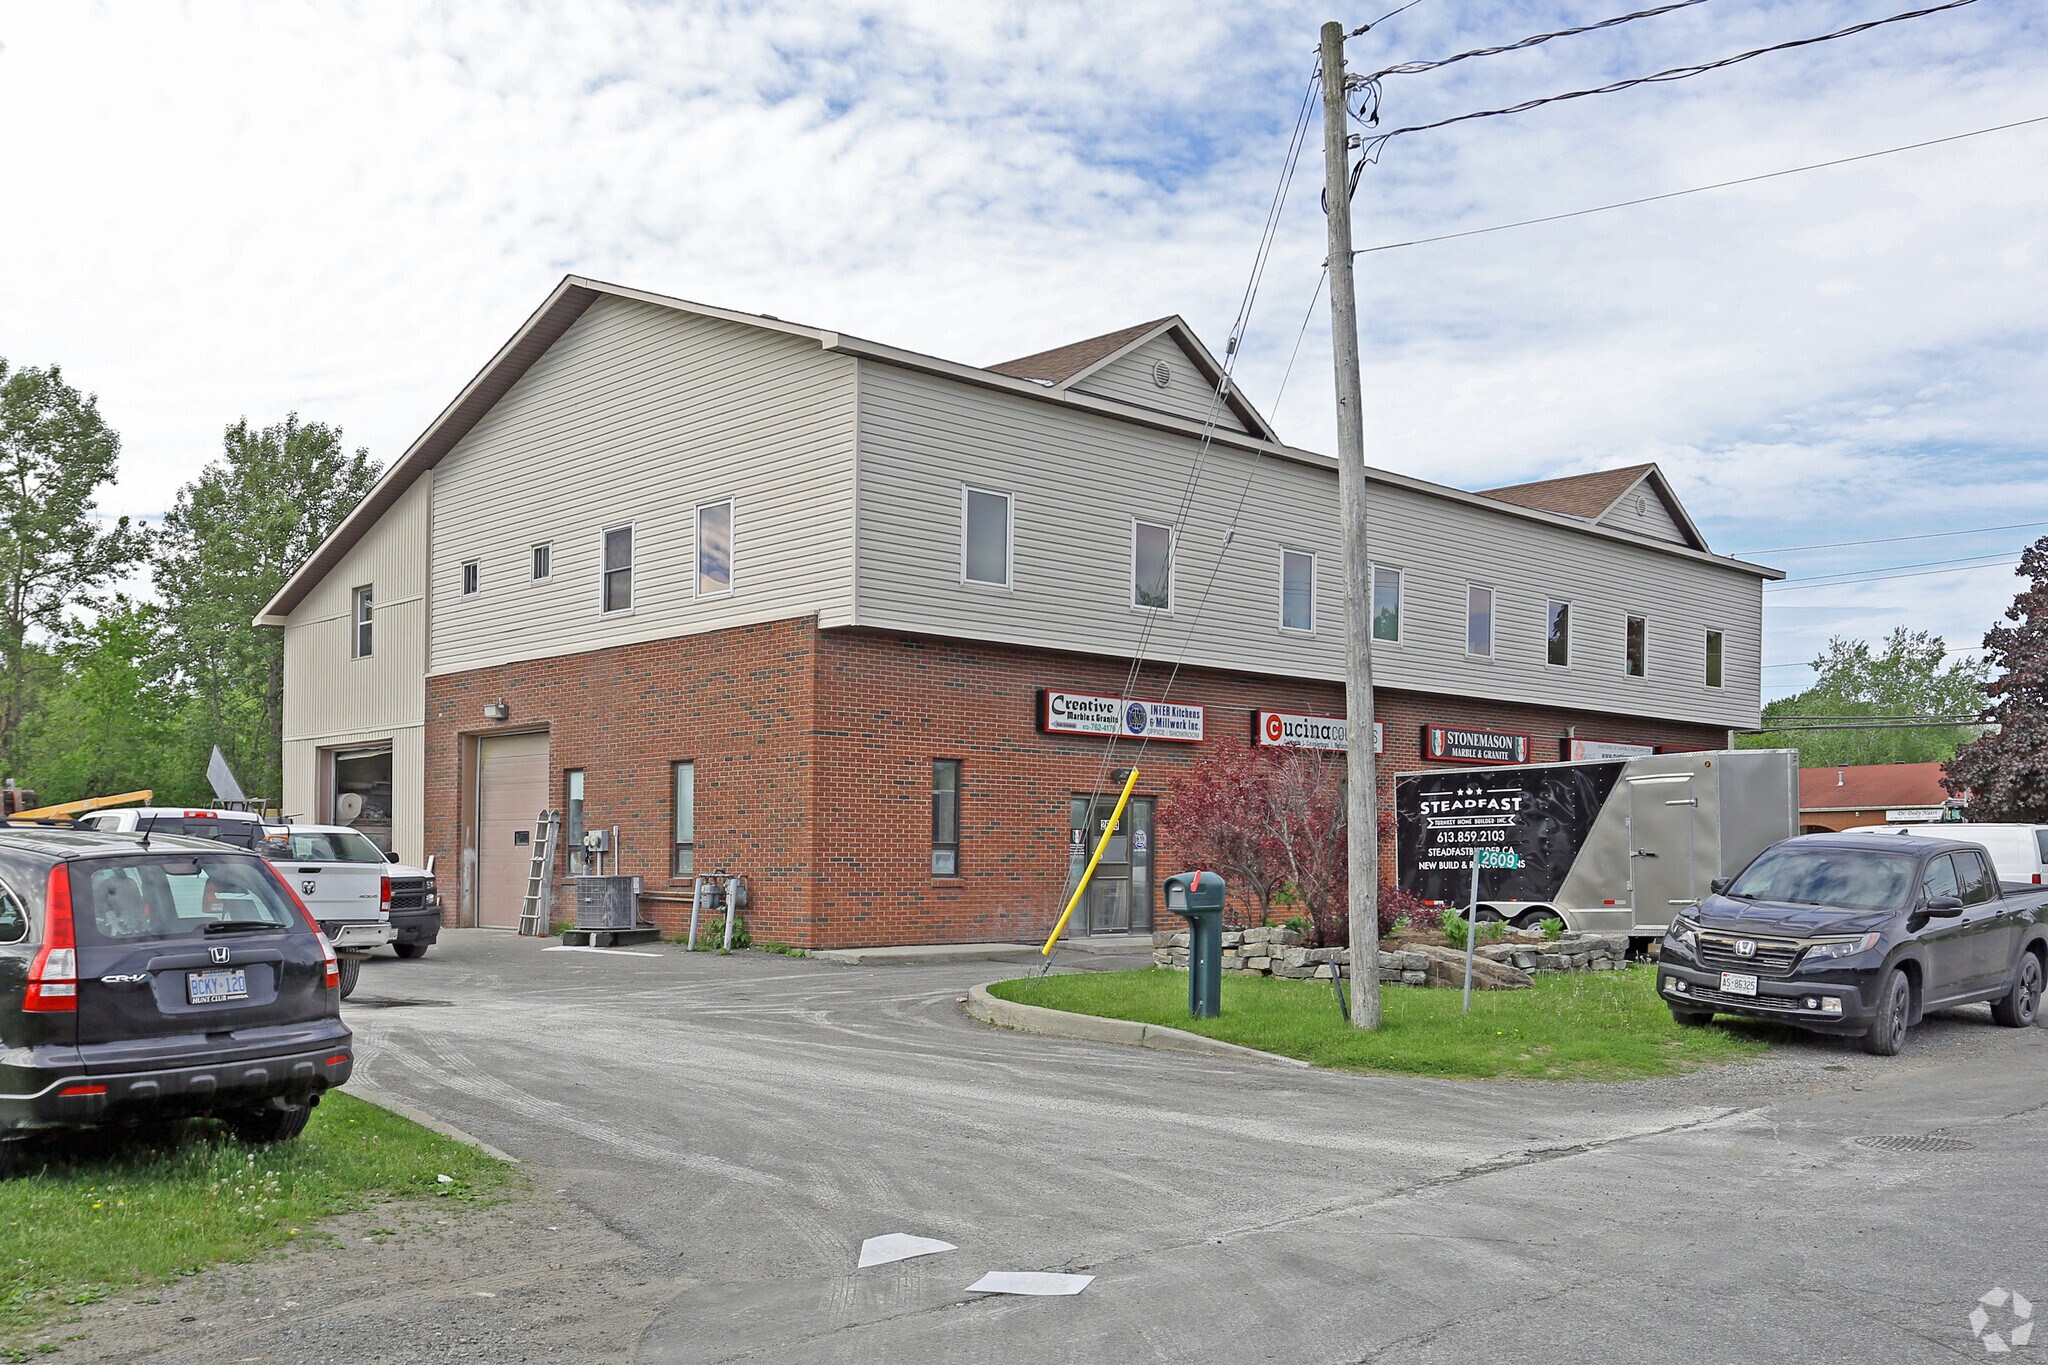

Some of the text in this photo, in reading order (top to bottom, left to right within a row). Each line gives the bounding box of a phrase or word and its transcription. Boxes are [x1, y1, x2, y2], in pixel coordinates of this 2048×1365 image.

[1051, 695, 1114, 715] Creative
[1150, 704, 1200, 719] INTER Kitchens
[1067, 711, 1090, 721] Marble
[1096, 713, 1118, 723] Granite
[1149, 717, 1201, 731] & Millwork Inc.
[1147, 728, 1165, 737] OFFICE
[1169, 729, 1200, 738] SHOWROOM
[1447, 731, 1513, 749] STONEMASON
[1451, 747, 1509, 760] MARBLE & GRANITE
[1420, 797, 1523, 815] STEADFAST
[1436, 830, 1505, 843] 613.859.2103
[1418, 861, 1437, 870] NEW
[1438, 860, 1460, 869] BUILD
[1461, 860, 1468, 869] &
[1481, 851, 1515, 868] 2609
[100, 973, 146, 983] CR-V
[1722, 978, 1755, 991] AS 86325
[191, 975, 245, 995] BCKY 120
[192, 996, 210, 1004] HUNT
